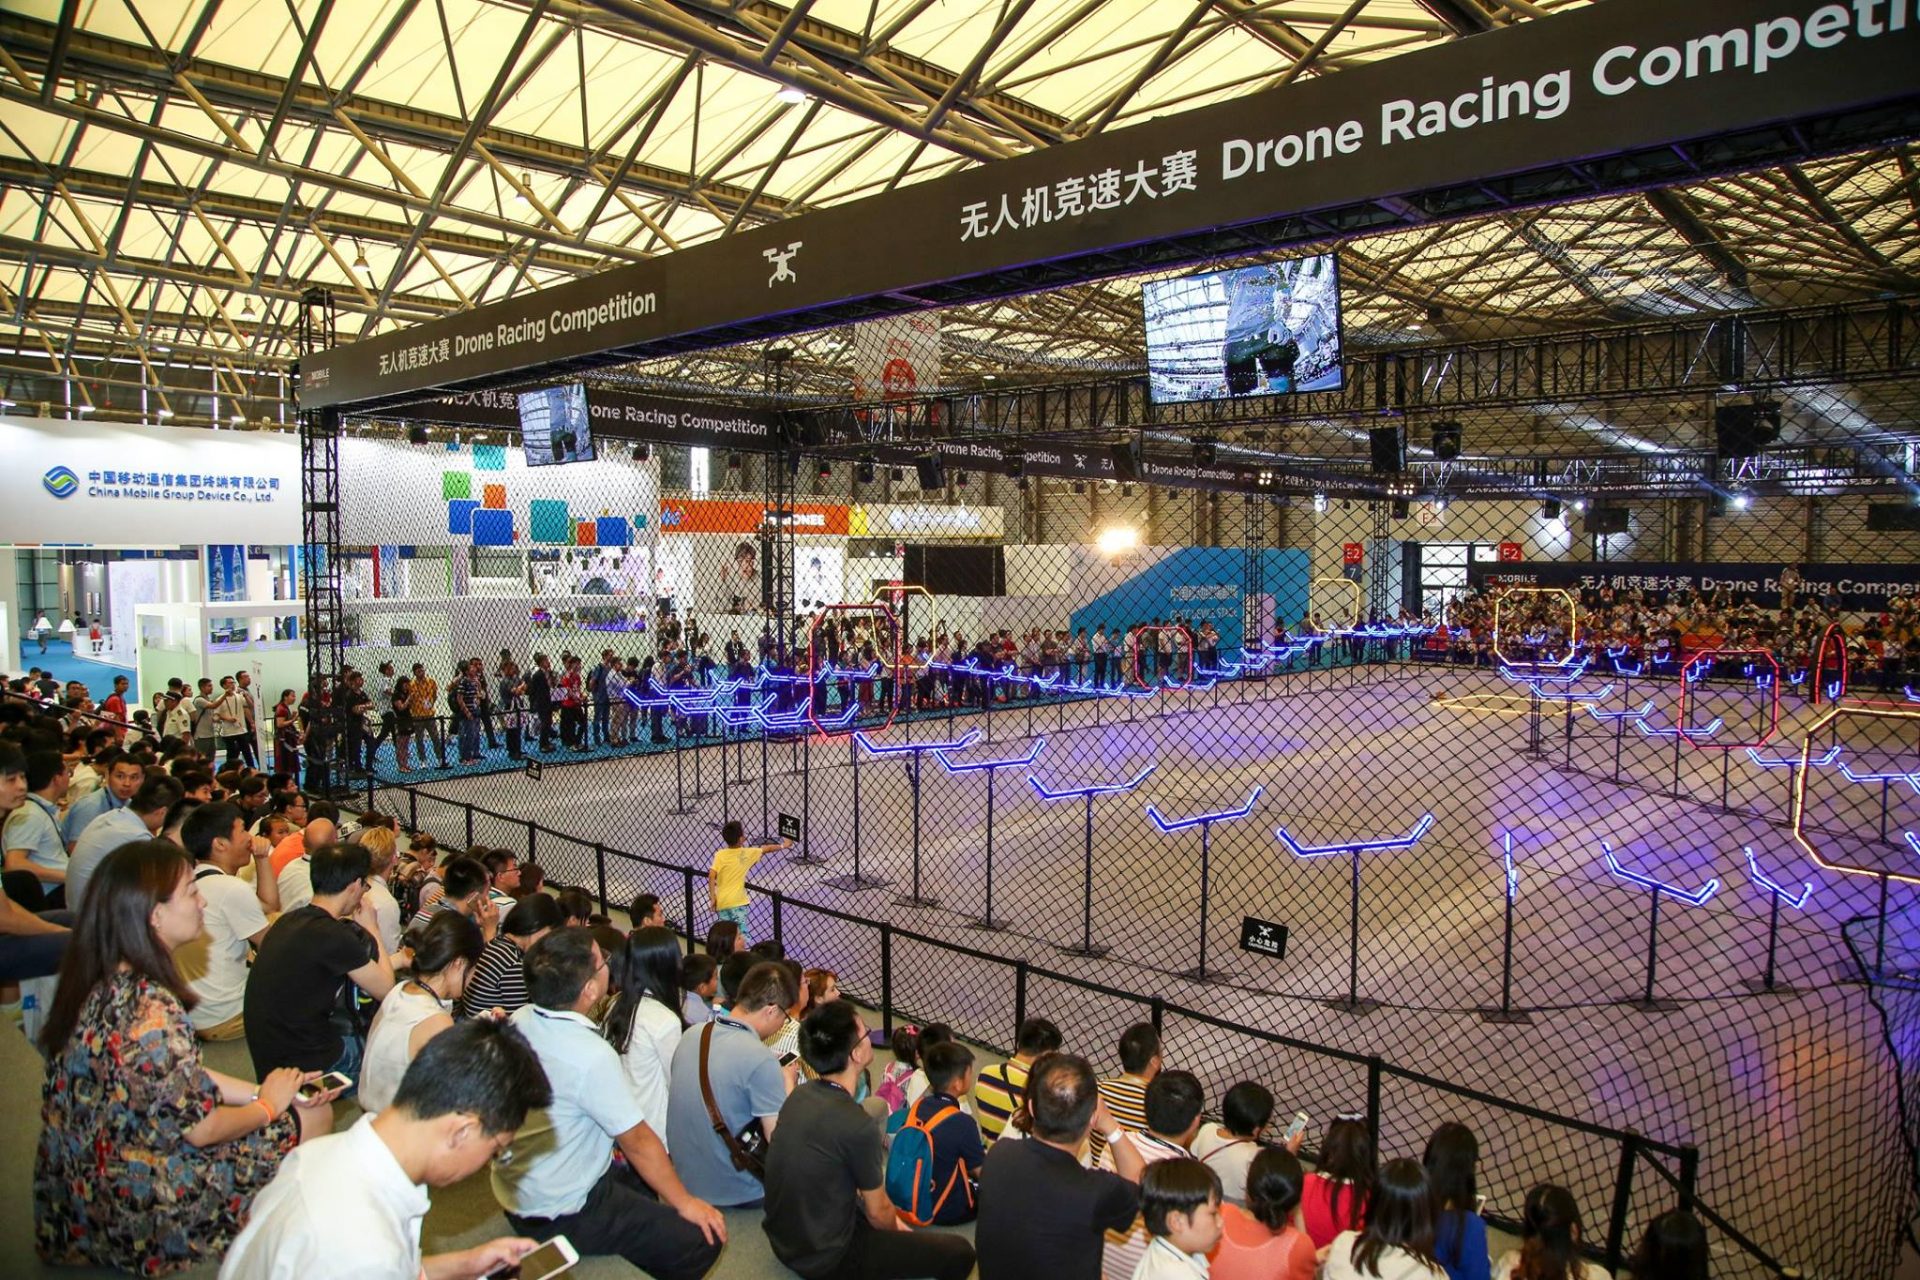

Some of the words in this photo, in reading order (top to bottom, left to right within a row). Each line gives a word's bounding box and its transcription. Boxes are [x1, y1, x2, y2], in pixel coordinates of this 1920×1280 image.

[960, 150, 1198, 242] 无人机竞速大赛
[1222, 117, 1364, 181] Drone
[1381, 70, 1570, 145] Racing
[1592, 0, 1920, 95] Competi
[379, 338, 450, 376] 无人机竞速大赛
[455, 330, 493, 357] Drone
[497, 317, 546, 346] Racing
[550, 292, 656, 335] Competition
[625, 406, 676, 428] Racing
[681, 412, 768, 436] Competition
[970, 444, 1003, 461] Racing
[88, 470, 281, 491] 中国移动通信集团终端有限公司
[88, 487, 120, 498] China
[123, 488, 160, 499] Mobile
[162, 489, 195, 502] Group
[198, 490, 231, 501] Device
[233, 491, 253, 502] Co.,
[255, 492, 275, 502] Ltd.
[1503, 549, 1519, 561] E2
[1702, 577, 1758, 592] Drone
[1764, 578, 1832, 597] Ring
